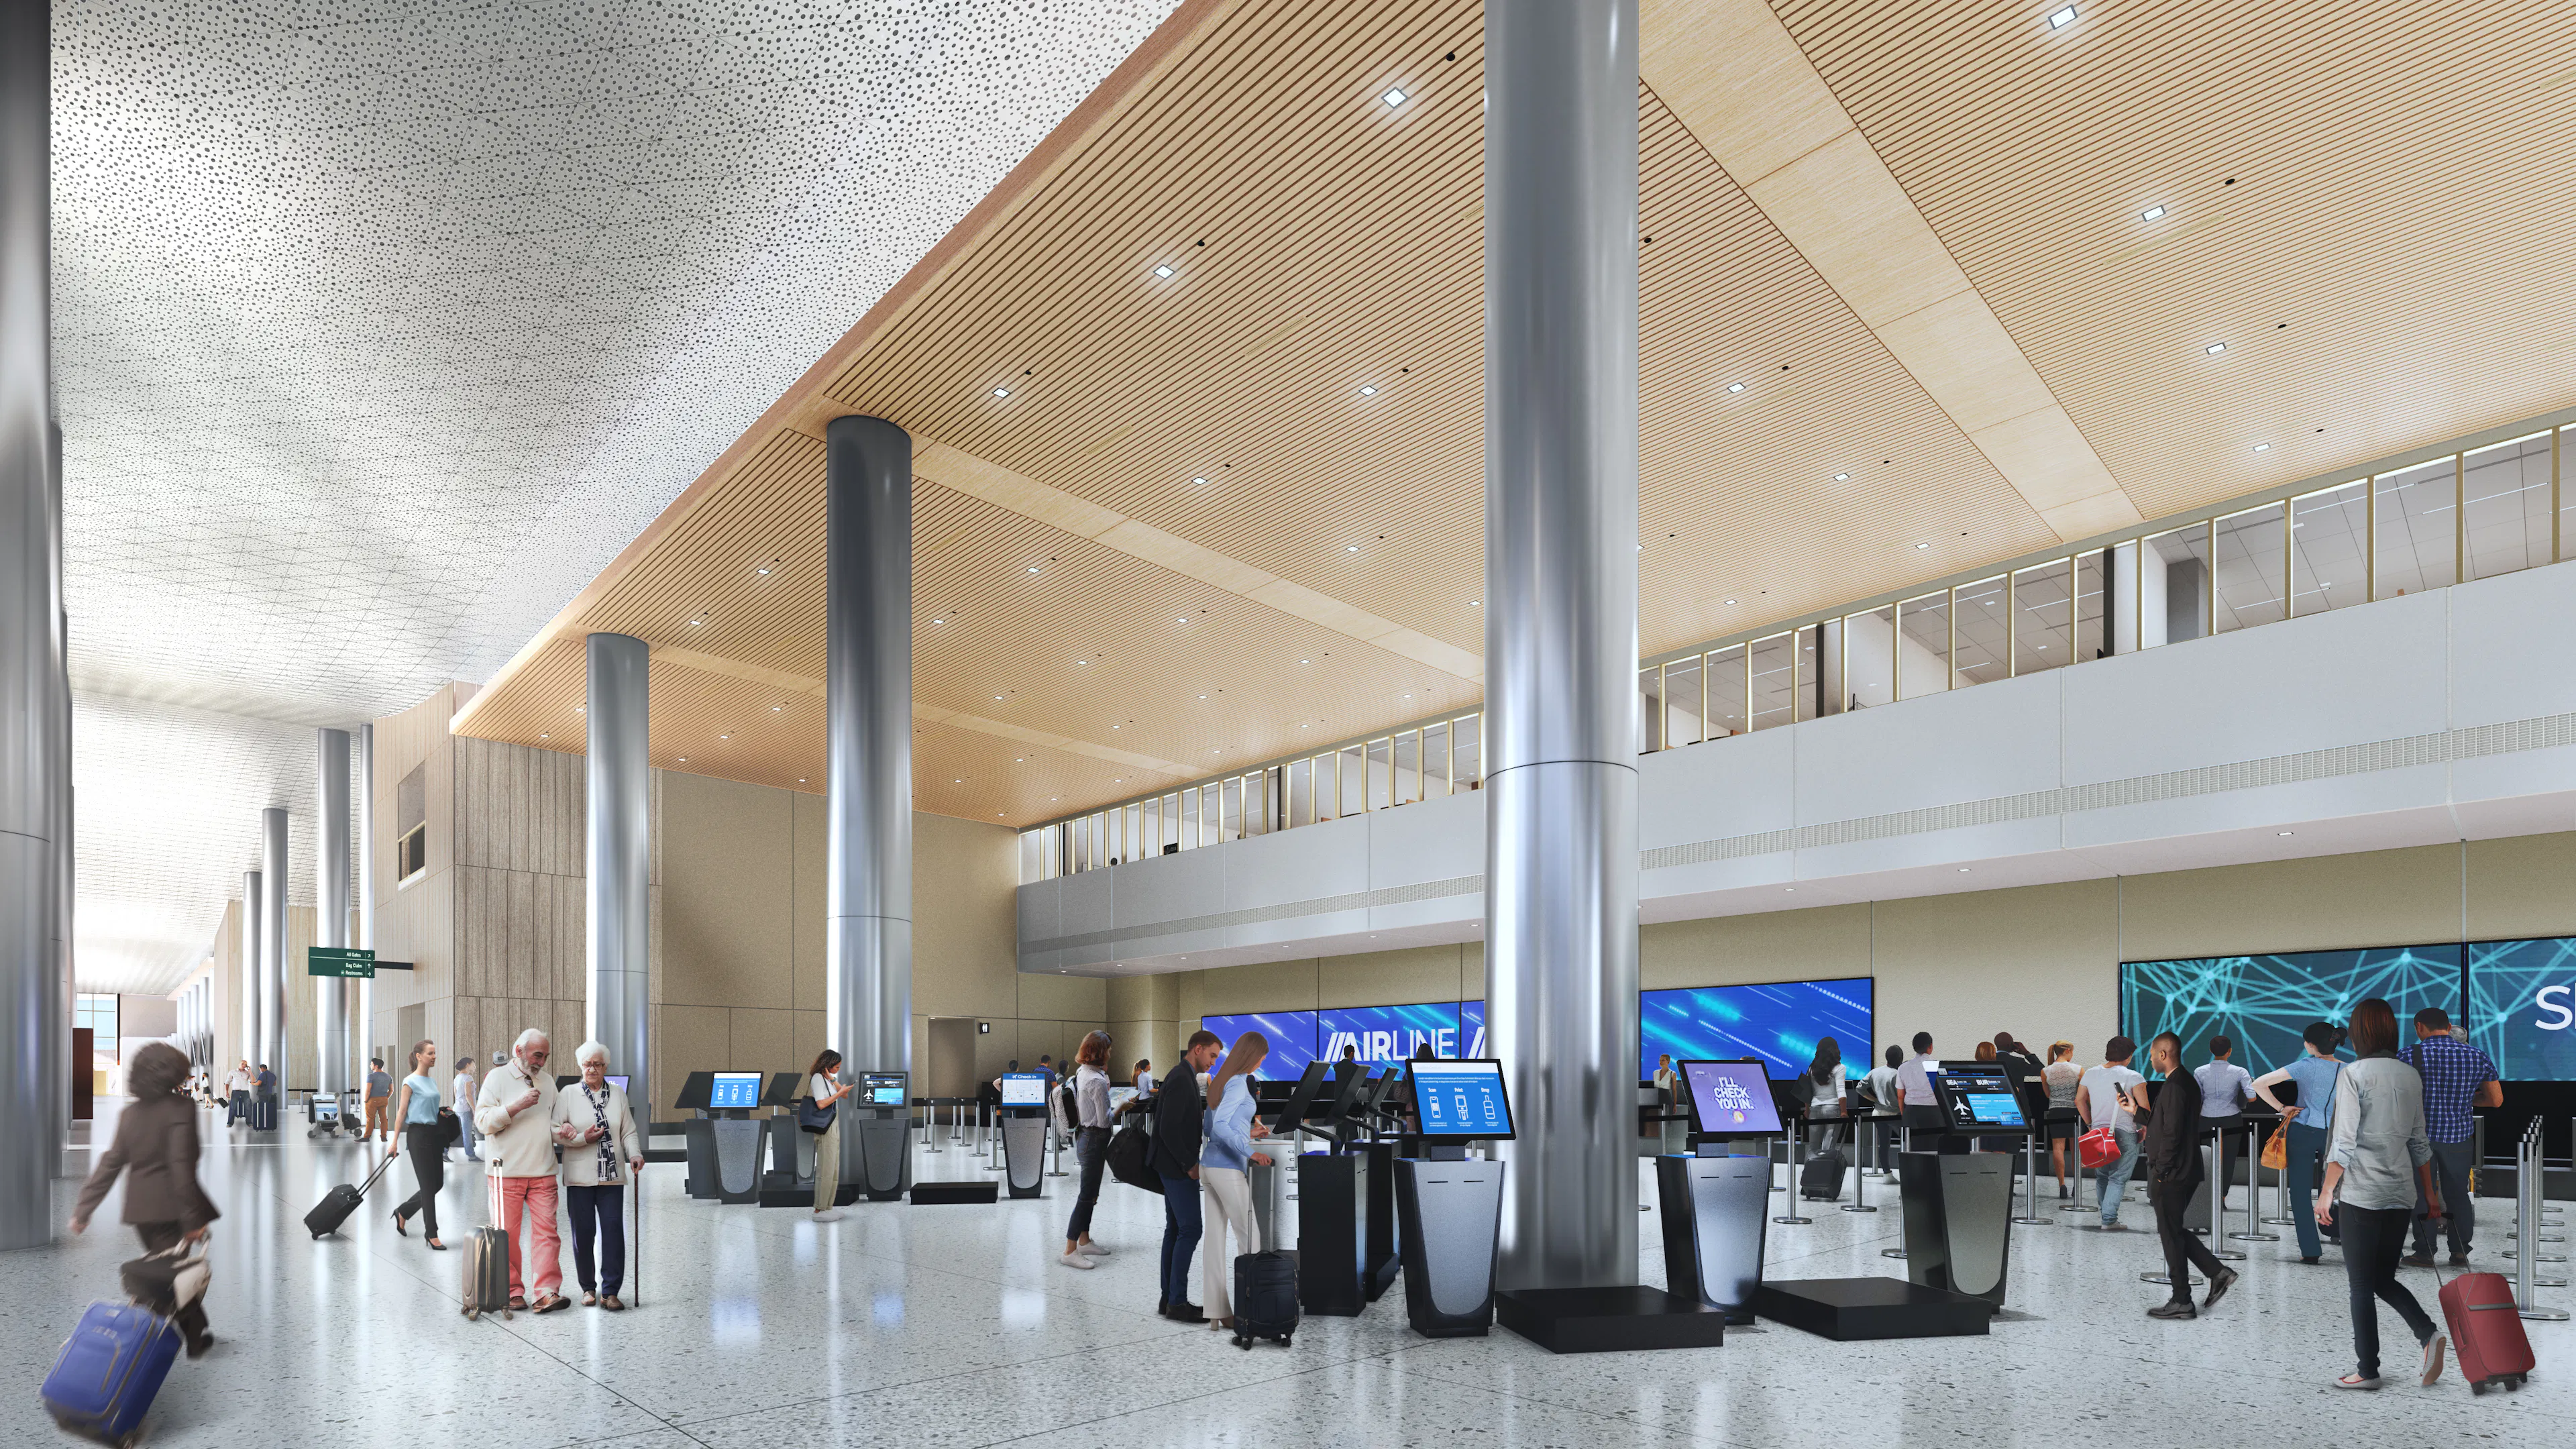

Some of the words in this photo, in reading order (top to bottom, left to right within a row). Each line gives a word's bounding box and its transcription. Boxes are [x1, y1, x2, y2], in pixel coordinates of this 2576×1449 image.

[2534, 982, 2576, 1030] S
[1334, 1028, 1455, 1062] AIRLINE
[1718, 1077, 1739, 1087] I'LL
[1713, 1087, 1750, 1099] CHECK
[1715, 1097, 1738, 1110] YOU
[1738, 1098, 1754, 1110] IN.
